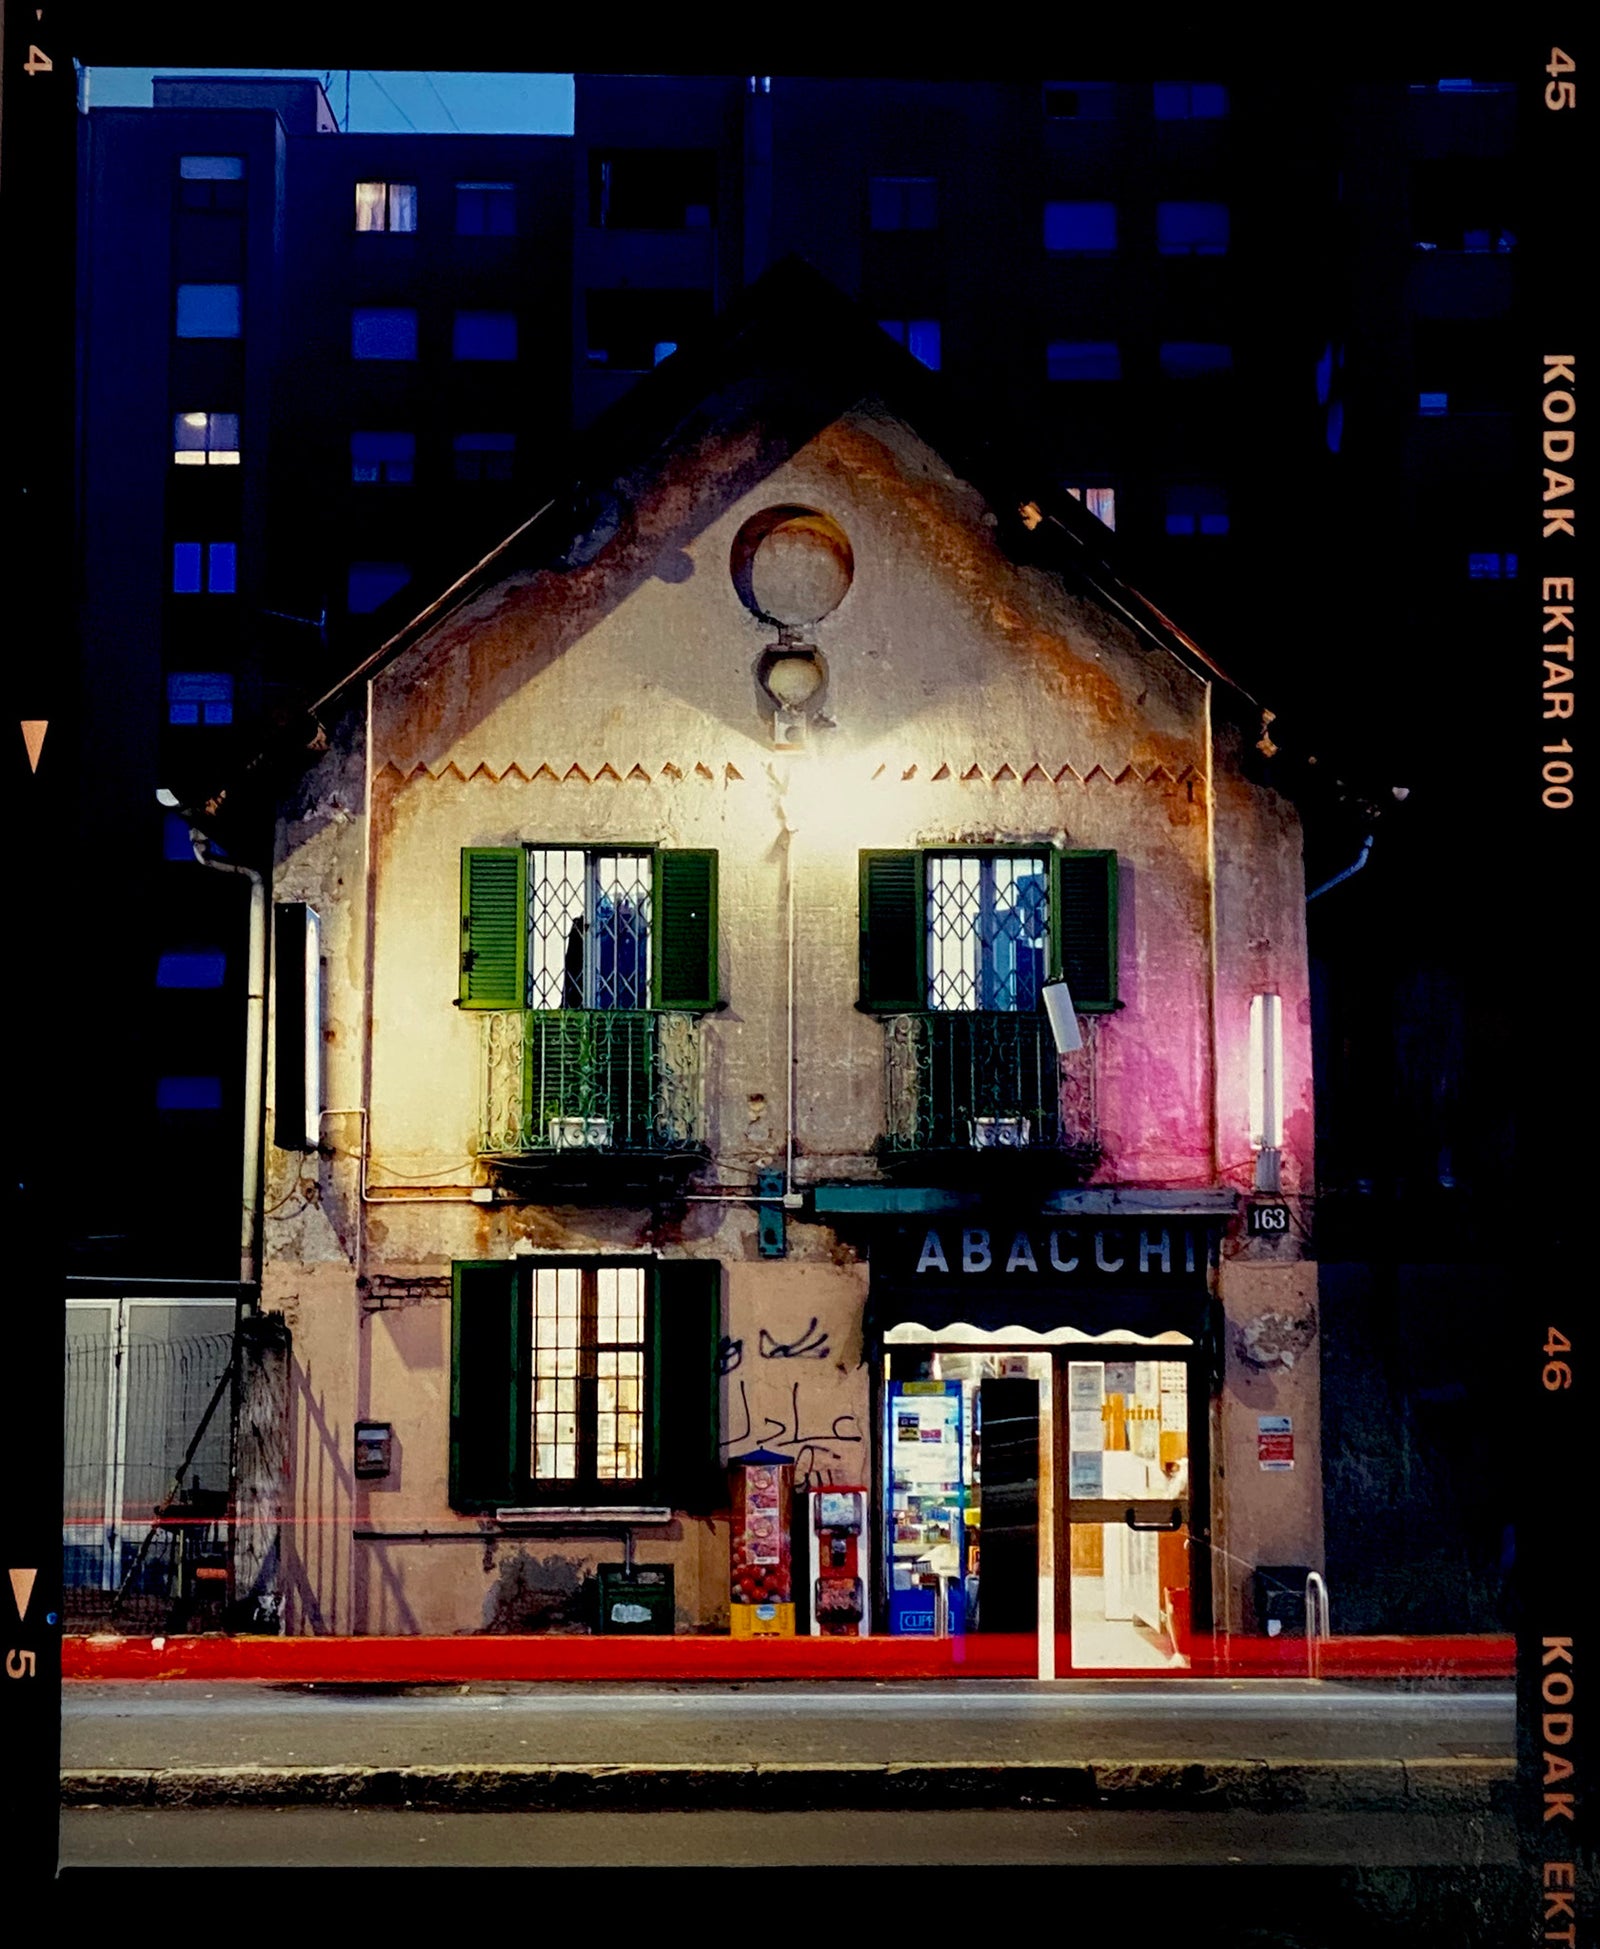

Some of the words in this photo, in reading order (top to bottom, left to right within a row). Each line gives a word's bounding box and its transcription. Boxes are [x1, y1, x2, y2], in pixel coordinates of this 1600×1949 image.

[23, 44, 53, 76] 4
[1543, 46, 1576, 111] 45
[1542, 354, 1575, 538] KODAK
[1542, 576, 1574, 719] EKTAR
[1541, 738, 1574, 809] 100
[1253, 1208, 1286, 1230] 163
[1541, 1326, 1573, 1391] 46
[6, 1648, 36, 1679] 5
[1542, 1636, 1575, 1821] KODAK
